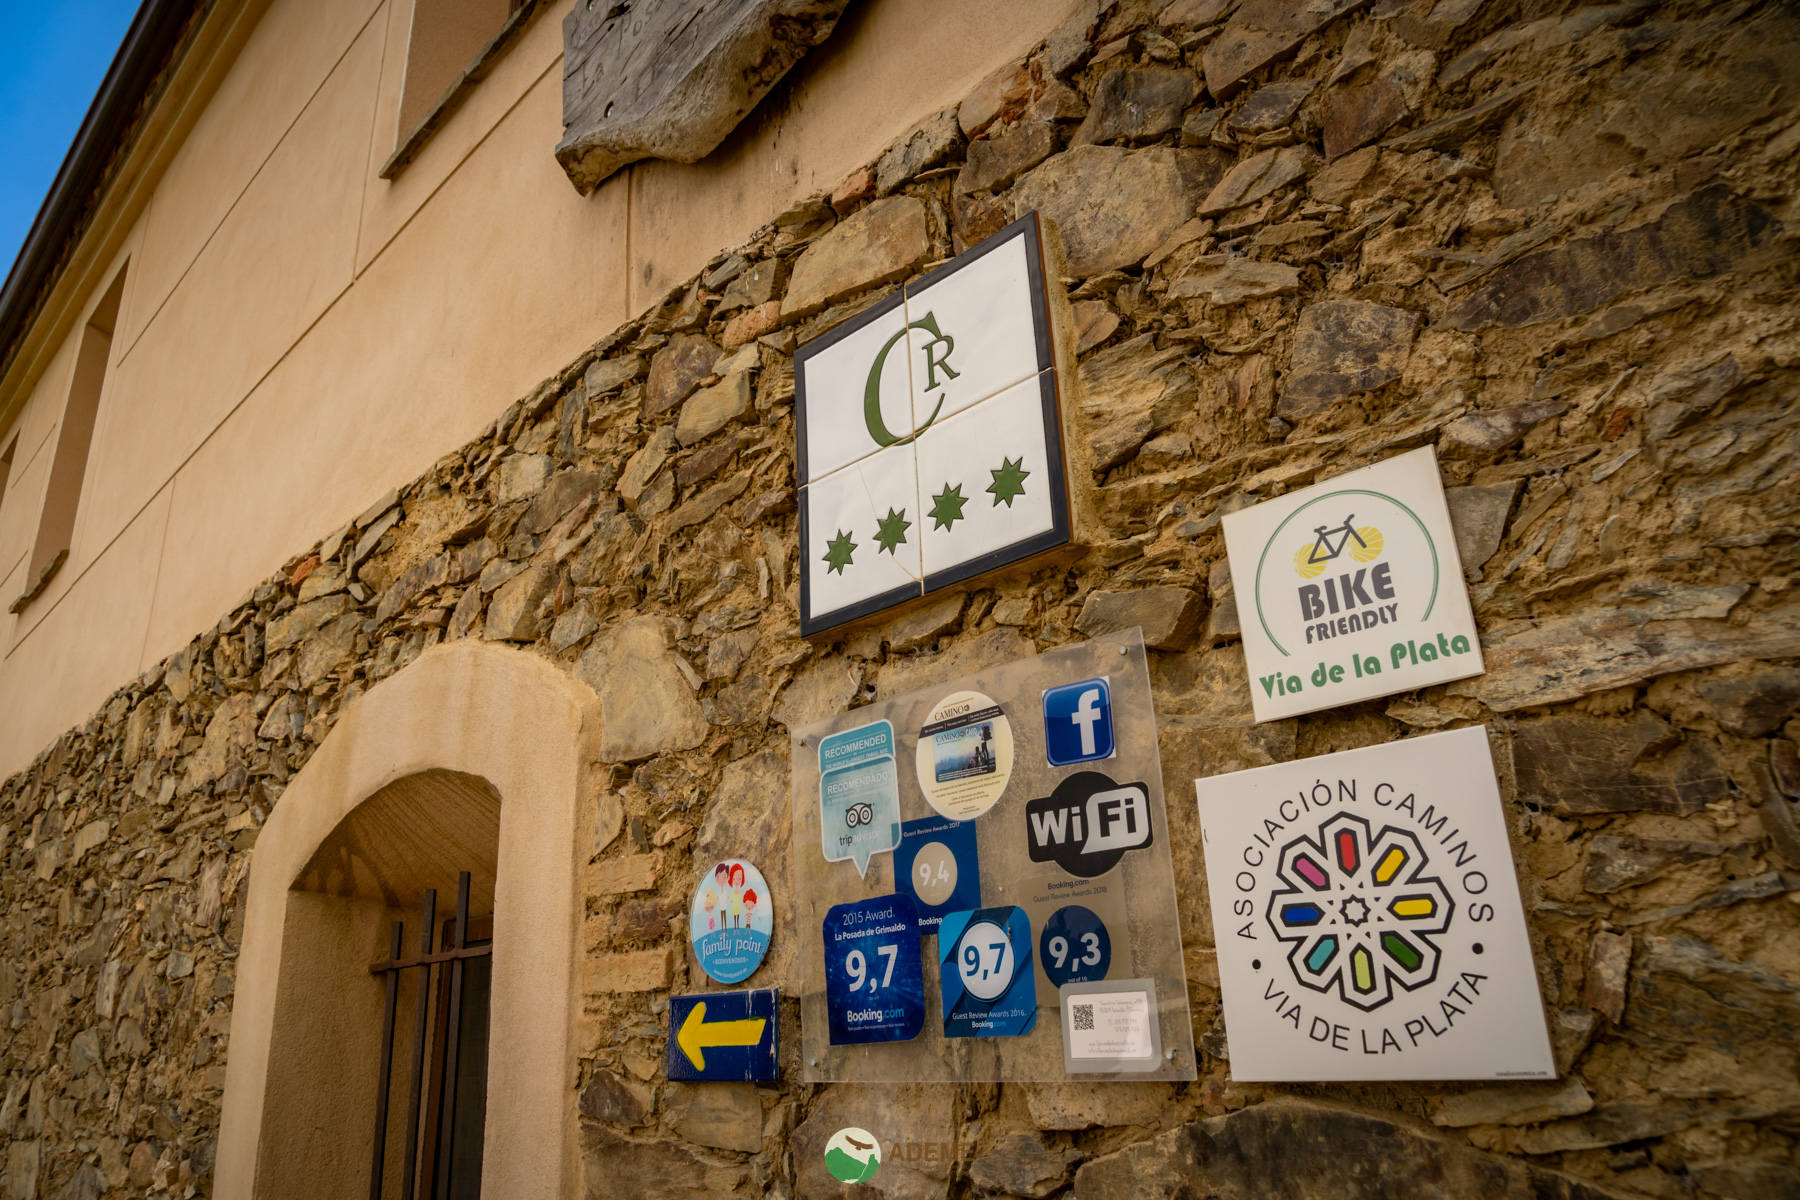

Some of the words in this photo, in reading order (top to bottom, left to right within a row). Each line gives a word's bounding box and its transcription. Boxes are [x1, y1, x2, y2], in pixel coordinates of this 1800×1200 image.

[1297, 561, 1396, 622] BIKE
[1304, 602, 1399, 645] FRIENDLY
[1259, 671, 1303, 700] Via
[1311, 662, 1345, 688] de
[1352, 653, 1382, 679] la
[1389, 632, 1471, 670] Plata
[934, 704, 965, 722] CAMINO
[824, 734, 887, 759] RECOMMENDED
[935, 731, 961, 744] CAMINO
[965, 727, 978, 736] CARD
[827, 771, 889, 795] RECOMENDADO
[903, 830, 917, 838] Guest
[916, 827, 932, 835] Review
[932, 823, 948, 832] Awards
[948, 821, 961, 829] 2017
[1233, 778, 1357, 941] ASOCIACIÓN
[1373, 782, 1495, 923] CAMINOS
[919, 860, 950, 888] 9,4
[1047, 879, 1090, 891] Booking.com
[1032, 894, 1050, 903] Guest
[1050, 891, 1070, 901] Review
[1071, 888, 1092, 898] Awards
[1093, 885, 1108, 895] 2018
[842, 911, 864, 926] 2015
[834, 933, 842, 942] La
[842, 929, 866, 940] Posada
[865, 928, 875, 936] de
[875, 922, 906, 935] Grimaldo
[702, 933, 732, 963] family
[735, 936, 762, 956] point
[1048, 932, 1102, 973] 9,3
[845, 944, 898, 993] 9,7
[963, 942, 1006, 981] 9,7
[847, 1007, 905, 1023] Booking.com
[952, 1011, 969, 1020] Guest
[968, 1010, 988, 1019] Review
[988, 1009, 1010, 1018] Awards
[1263, 977, 1302, 1029] VIA
[1309, 1015, 1350, 1051] DE
[1361, 1028, 1402, 1054] LA
[1404, 969, 1489, 1047] PLATA
[971, 1020, 1007, 1029] Booking.com
